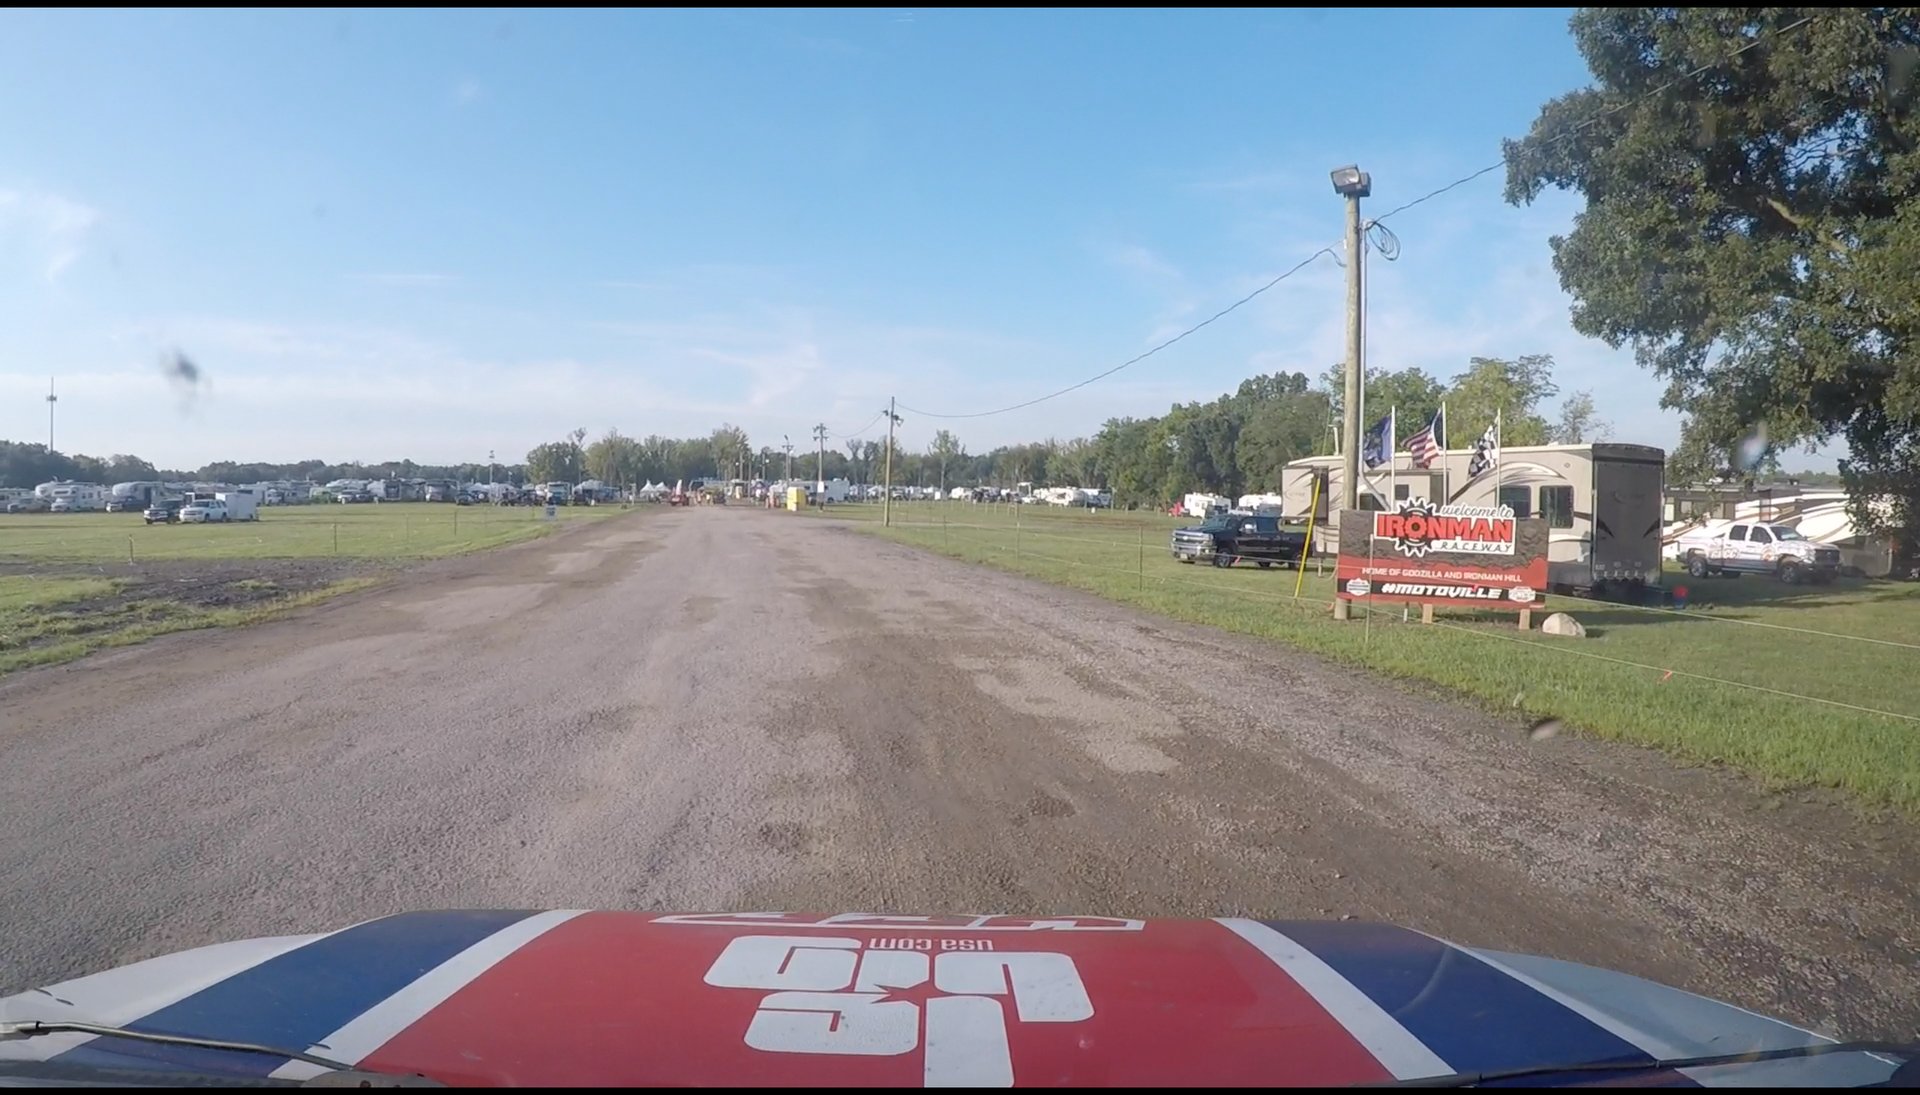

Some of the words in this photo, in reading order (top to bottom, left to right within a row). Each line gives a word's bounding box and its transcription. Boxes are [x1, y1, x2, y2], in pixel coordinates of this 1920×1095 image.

[1441, 502, 1496, 517] welcome
[1499, 504, 1514, 518] to
[1376, 513, 1514, 542] IRONMAN
[1440, 541, 1512, 552] RACEWAY
[1362, 567, 1388, 576] HOME
[1389, 568, 1401, 576] OF
[1402, 569, 1443, 578] GODZILLA
[1444, 571, 1463, 579] AND
[1463, 572, 1503, 581] IRONMAN
[1504, 574, 1523, 582] HILL
[869, 937, 994, 951] usa.com
